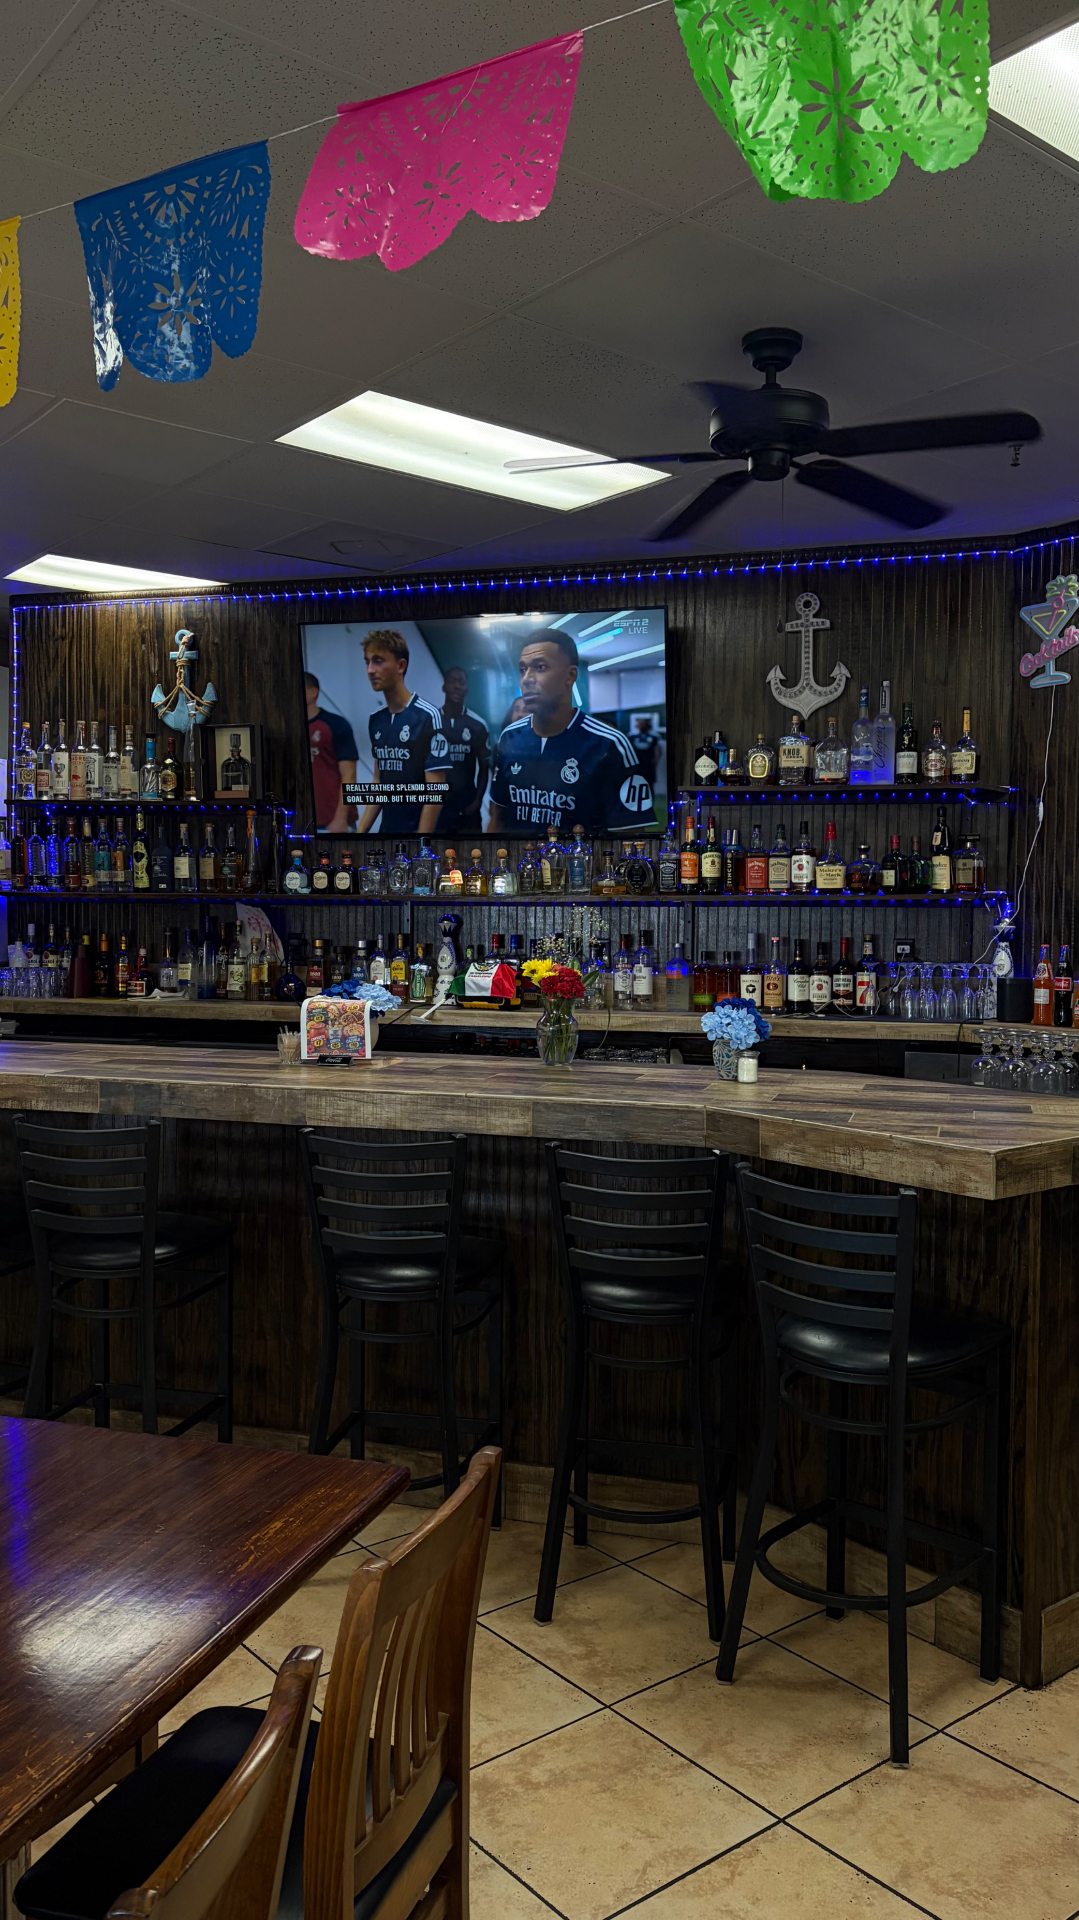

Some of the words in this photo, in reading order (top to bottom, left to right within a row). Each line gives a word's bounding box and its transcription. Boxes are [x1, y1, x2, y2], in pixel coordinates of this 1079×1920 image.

[613, 619, 640, 627] ESPN
[642, 618, 649, 626] 2
[628, 626, 649, 635] LIVE
[430, 732, 449, 758] hp
[783, 748, 800, 756] KNOB
[873, 722, 889, 769] Chopin
[346, 784, 369, 792] REALLY
[370, 784, 395, 792] RATHER
[396, 783, 425, 792] SPLENDID
[426, 783, 450, 791] SECOND
[621, 774, 652, 812] hp
[346, 795, 363, 803] GOAL
[365, 795, 374, 803] TO
[375, 795, 390, 803] ADD.
[391, 795, 403, 803] BUT
[405, 795, 417, 803] THE
[418, 794, 443, 803] OFFSIDE
[509, 784, 576, 810] Emirates
[516, 805, 529, 821] FLY
[531, 807, 562, 827] BETTER
